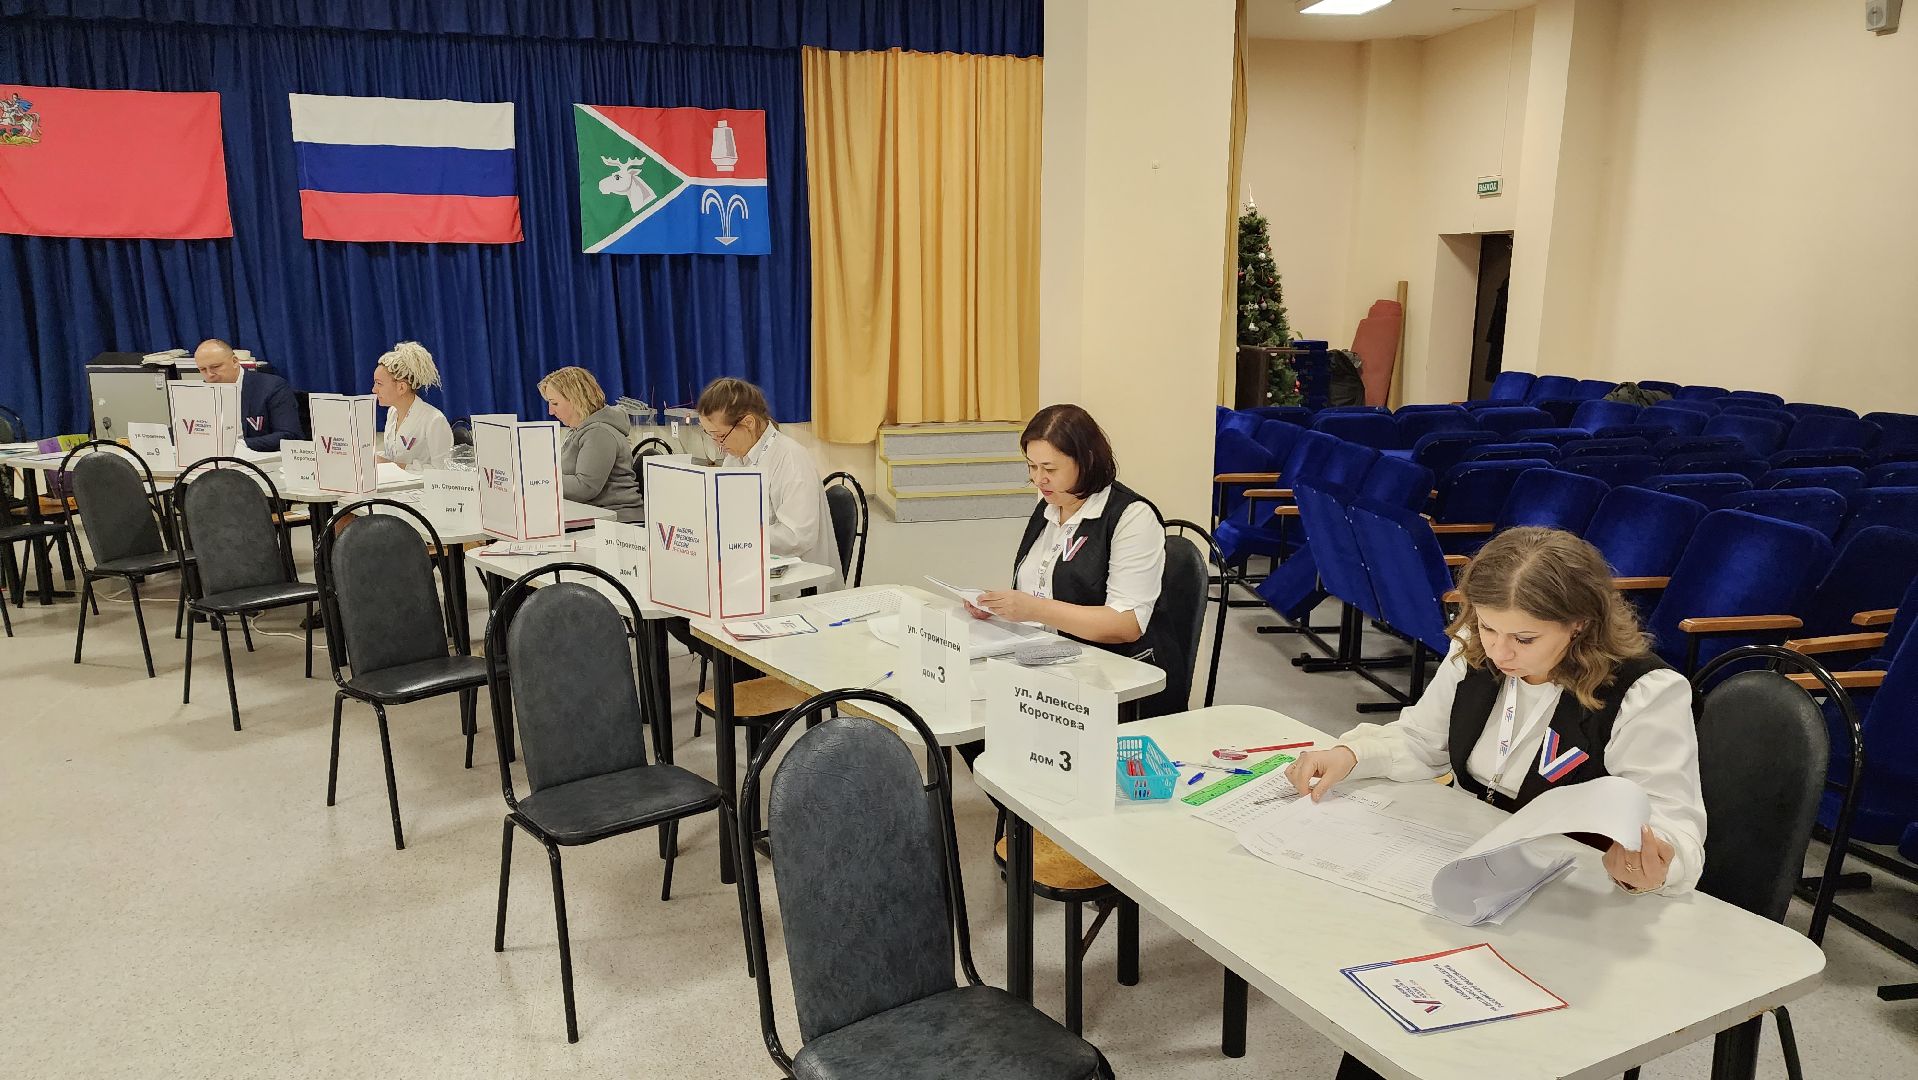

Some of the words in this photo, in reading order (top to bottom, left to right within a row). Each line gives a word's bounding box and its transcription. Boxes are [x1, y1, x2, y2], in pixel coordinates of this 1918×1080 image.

[478, 182, 498, 192] ВЫХОД
[457, 502, 465, 513] 7
[604, 538, 615, 546] ул.
[728, 542, 753, 551] ЦИК.РФ
[620, 568, 632, 576] дом
[632, 564, 638, 578] 1
[907, 624, 918, 634] ул.
[919, 627, 961, 653] Строителей
[922, 668, 936, 681] дом
[937, 665, 946, 684] 3
[1014, 686, 1033, 699] ул.
[1035, 690, 1090, 716] Алексея
[1019, 701, 1085, 731] Короткова
[1029, 751, 1054, 767] дом
[1058, 750, 1072, 772] 3
